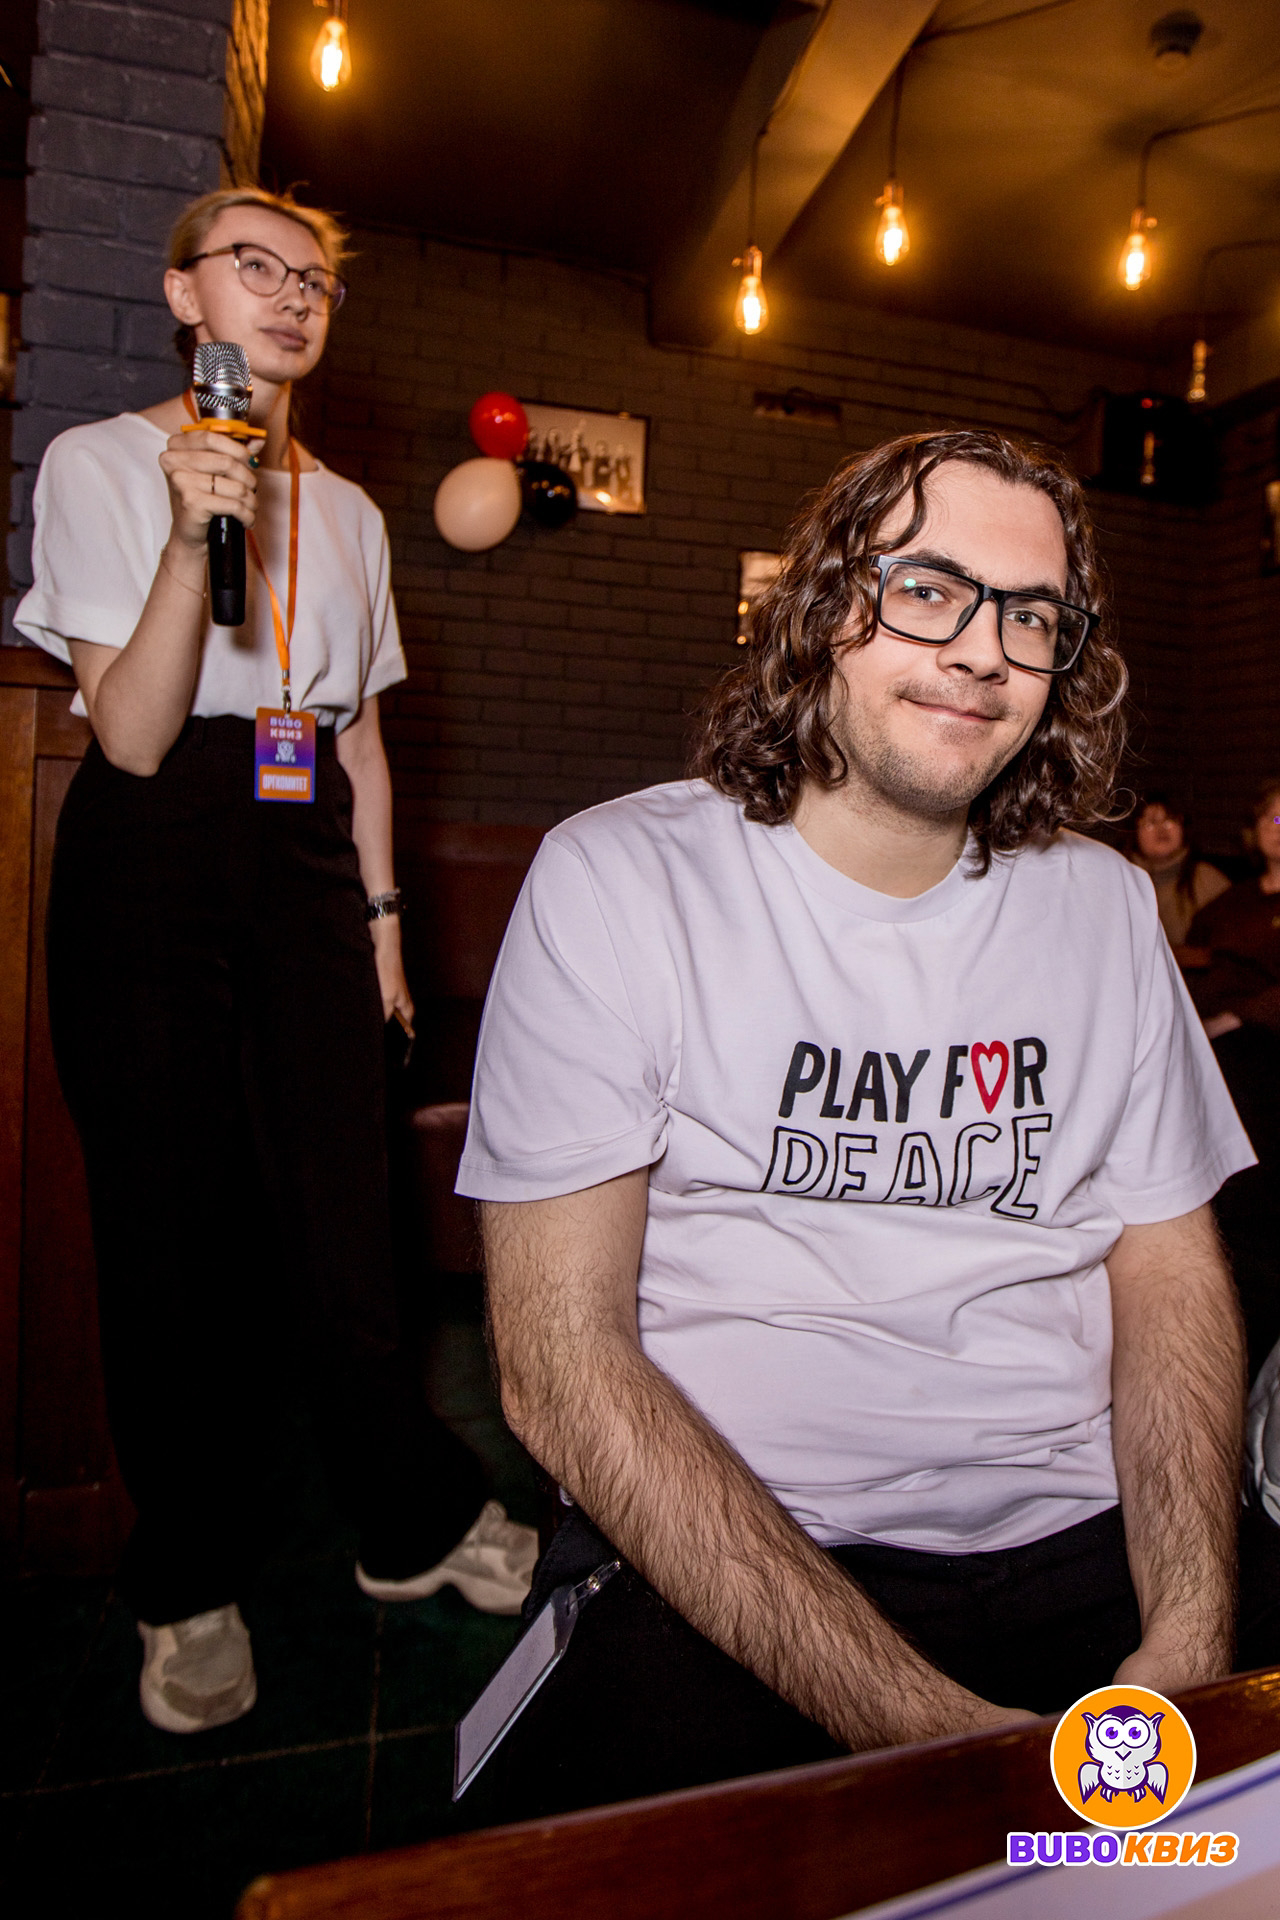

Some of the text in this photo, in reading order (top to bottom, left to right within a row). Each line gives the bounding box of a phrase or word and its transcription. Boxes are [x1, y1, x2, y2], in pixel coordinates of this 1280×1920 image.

[269, 716, 302, 729] BUBO
[270, 728, 303, 741] КВИЗ
[778, 1040, 931, 1123] PLAY
